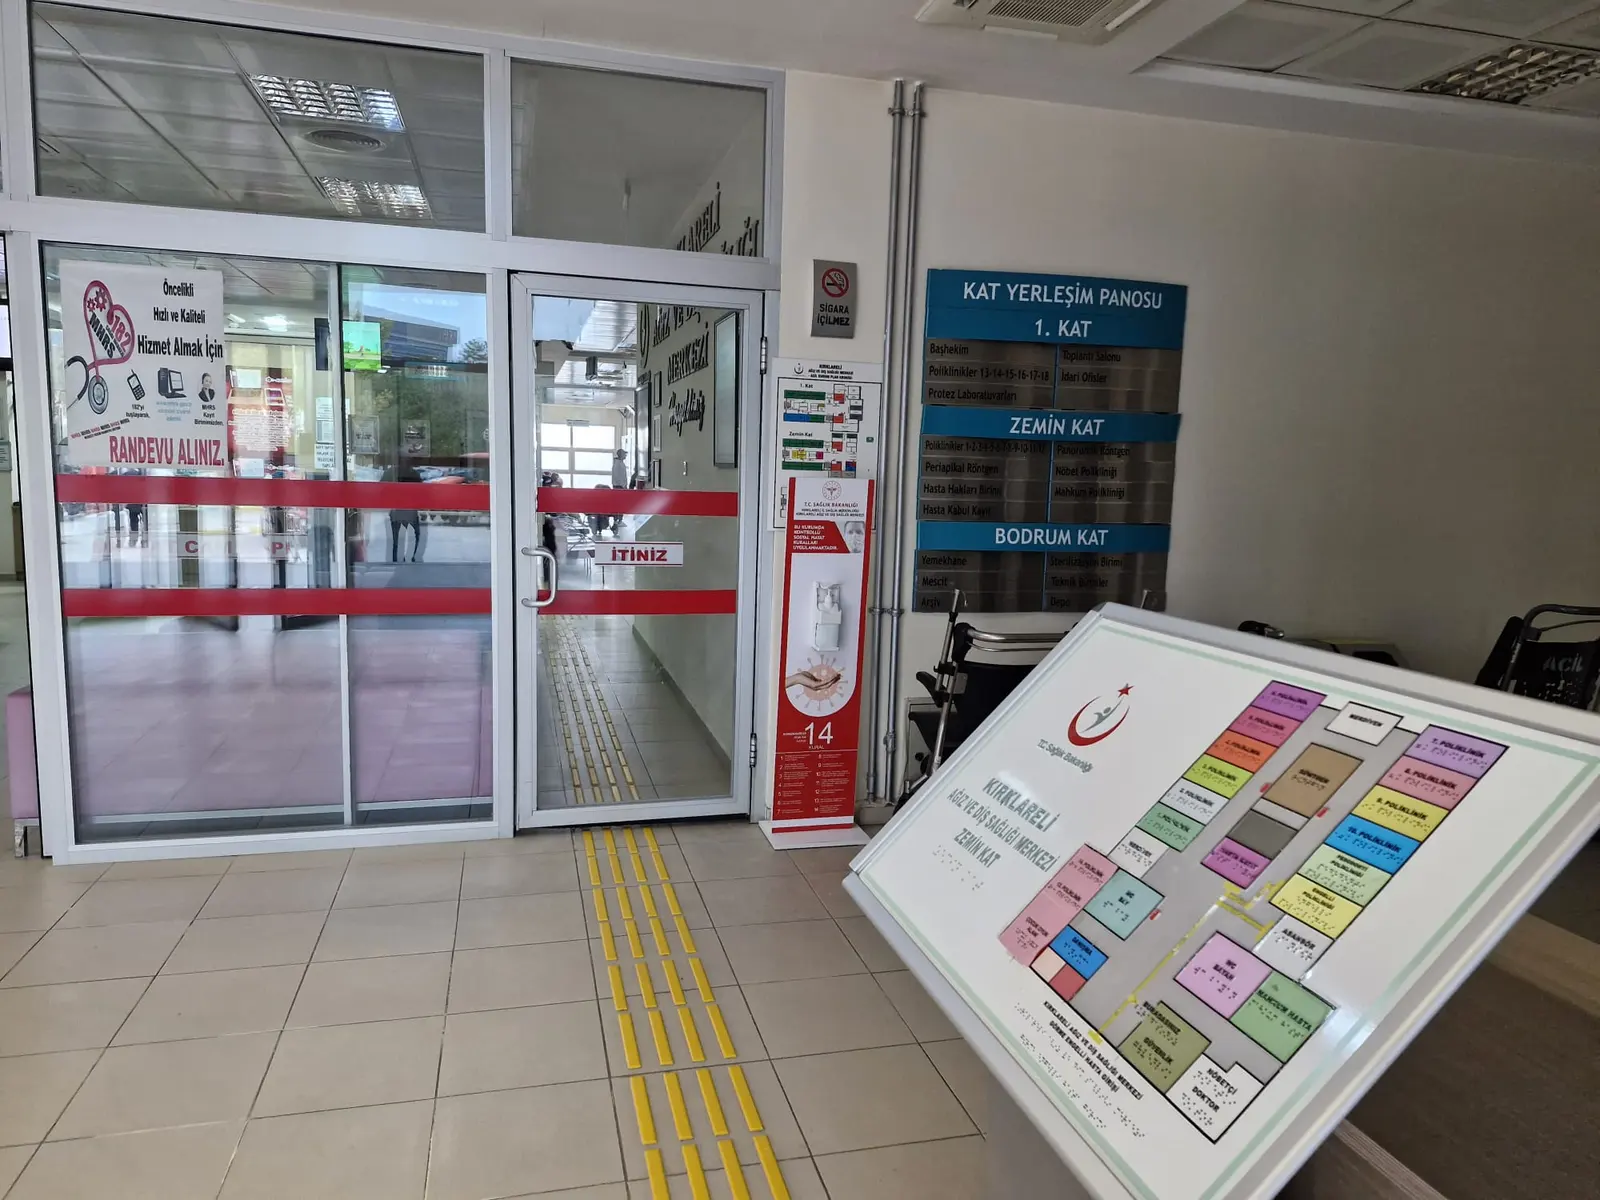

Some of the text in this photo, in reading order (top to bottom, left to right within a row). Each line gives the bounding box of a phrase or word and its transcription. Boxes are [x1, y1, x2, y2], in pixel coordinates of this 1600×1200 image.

[163, 278, 194, 297] Öncelikli
[964, 282, 1162, 309] KAT YERLEŞİM PANOSU
[153, 307, 206, 324] Hızlı ve Kaliteli
[820, 303, 849, 315] SİGARA
[817, 315, 850, 326] İÇİLMEZ
[1034, 319, 1092, 338] 1. KAT
[89, 312, 116, 358] MHRS
[111, 315, 132, 352] 182
[138, 334, 171, 356] Hizmet
[174, 337, 203, 358] Almak
[204, 334, 223, 362] İçin
[930, 343, 969, 357] Başhekim
[929, 364, 1049, 381] Poliklinikler 13-14-15-16-17-18
[928, 388, 955, 400] Protez
[1009, 414, 1105, 435] ZEMİN KAT
[109, 436, 224, 466] RANDEVU ALINIZ.
[923, 484, 946, 494] Hasta
[948, 484, 977, 495] Hakları
[923, 505, 945, 515] Hasta
[947, 505, 969, 516] Kabul
[995, 528, 1108, 546] BODRUM KAT
[612, 546, 668, 561] İTİNİZ
[921, 556, 968, 567] Yemekhane
[922, 577, 948, 587] Mescit
[805, 722, 833, 745] 14
[982, 778, 1061, 832] KIRKLARELİ
[947, 788, 970, 808] AĞIZ
[963, 799, 979, 815] VE
[972, 805, 991, 826] DİŞ
[1013, 836, 1061, 872] MERKEZİ
[954, 828, 1001, 868] ZEMİN KAT
[1081, 1037, 1089, 1046] VE
[1117, 1074, 1144, 1100] MERKEZİ
[1206, 1067, 1238, 1096] NÖBETÇİ
[1191, 1086, 1220, 1113] DOKTOR
